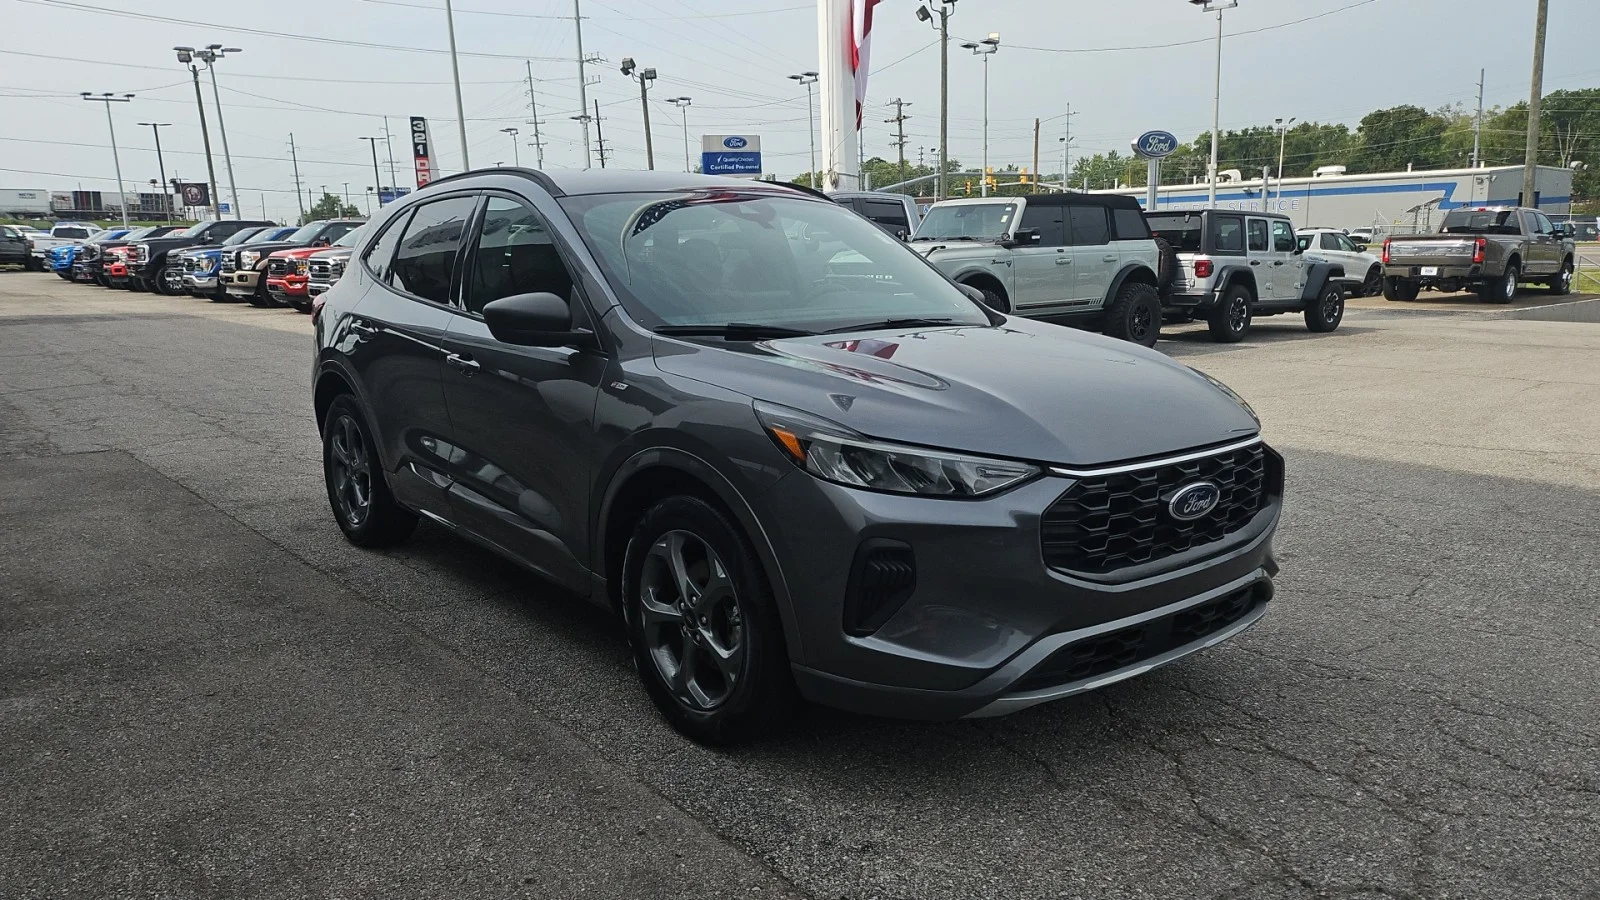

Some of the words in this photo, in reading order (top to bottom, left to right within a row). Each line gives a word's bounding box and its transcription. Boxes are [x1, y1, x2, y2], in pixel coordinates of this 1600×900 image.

[729, 138, 744, 147] Ford
[1146, 135, 1170, 152] Ford
[1228, 199, 1299, 212] SERICE
[1183, 491, 1212, 513] Ford
